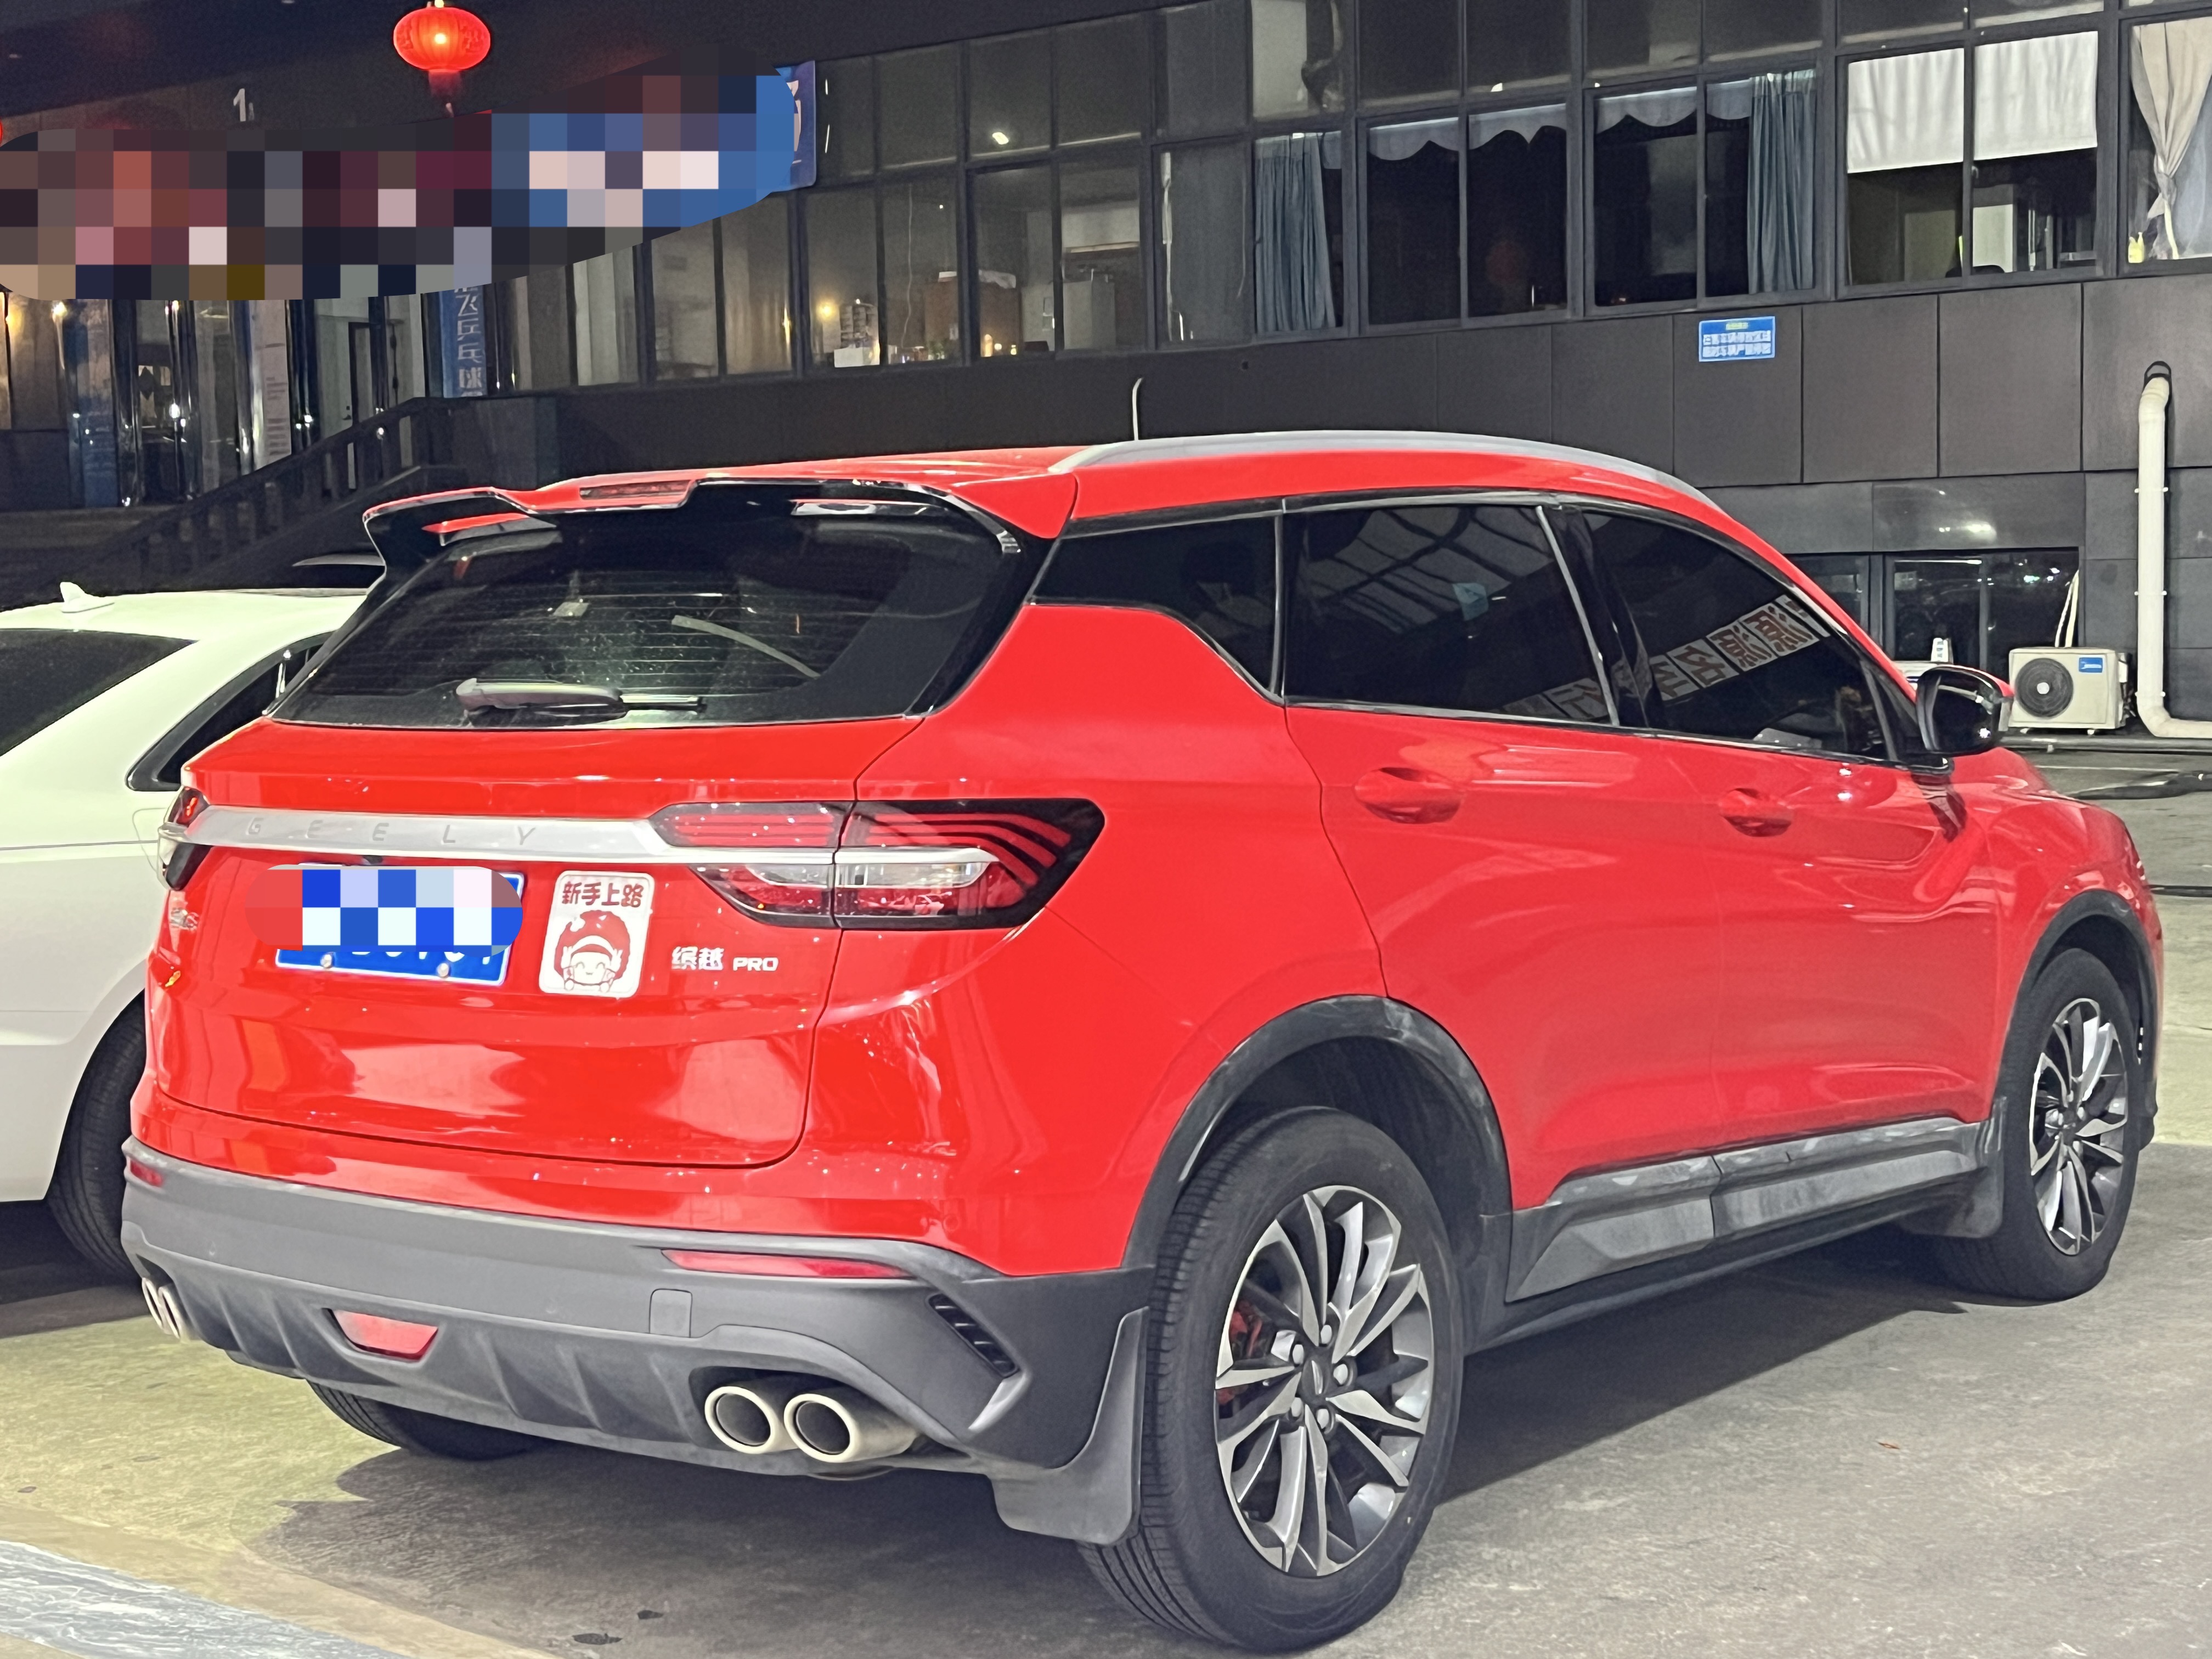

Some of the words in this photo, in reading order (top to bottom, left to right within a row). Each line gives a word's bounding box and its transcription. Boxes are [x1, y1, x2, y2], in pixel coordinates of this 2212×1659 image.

[454, 287, 483, 397] 飞乒乓球
[245, 817, 536, 845] GEELY
[562, 881, 644, 908] 新手上路
[672, 946, 724, 970] 缤越
[733, 957, 778, 971] PRO
